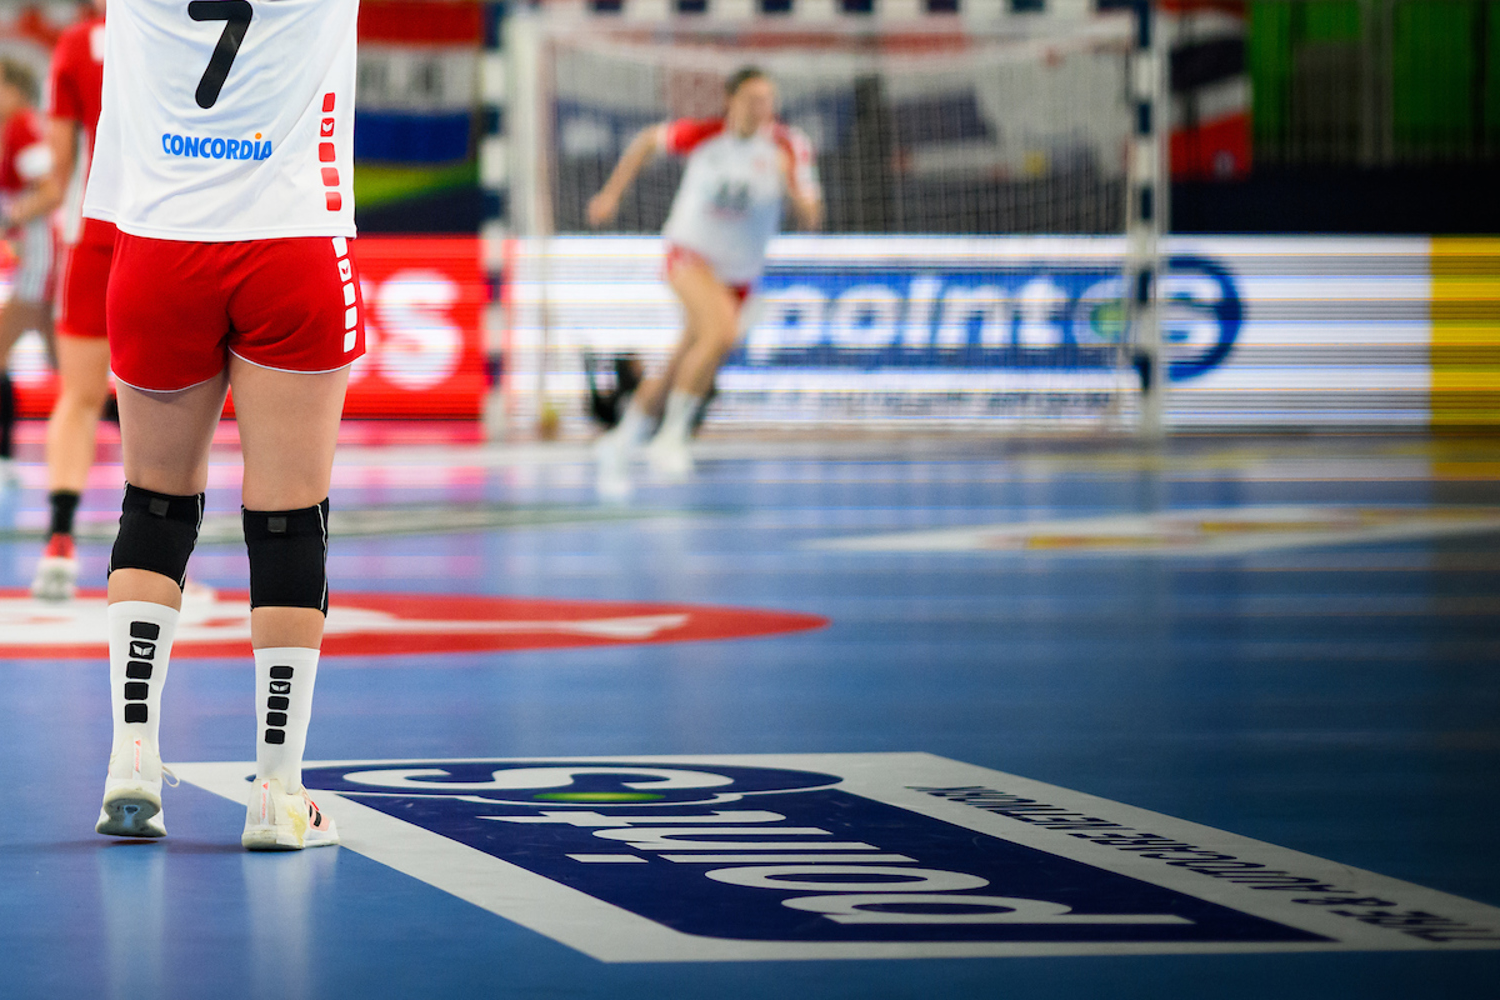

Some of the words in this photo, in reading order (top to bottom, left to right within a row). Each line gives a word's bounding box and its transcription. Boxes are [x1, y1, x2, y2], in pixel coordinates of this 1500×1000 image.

[187, 0, 253, 109] 7
[903, 785, 1137, 831] NETWORK
[476, 809, 1196, 925] point
[1055, 832, 1358, 894] AUTOCARE
[1290, 896, 1399, 907] &
